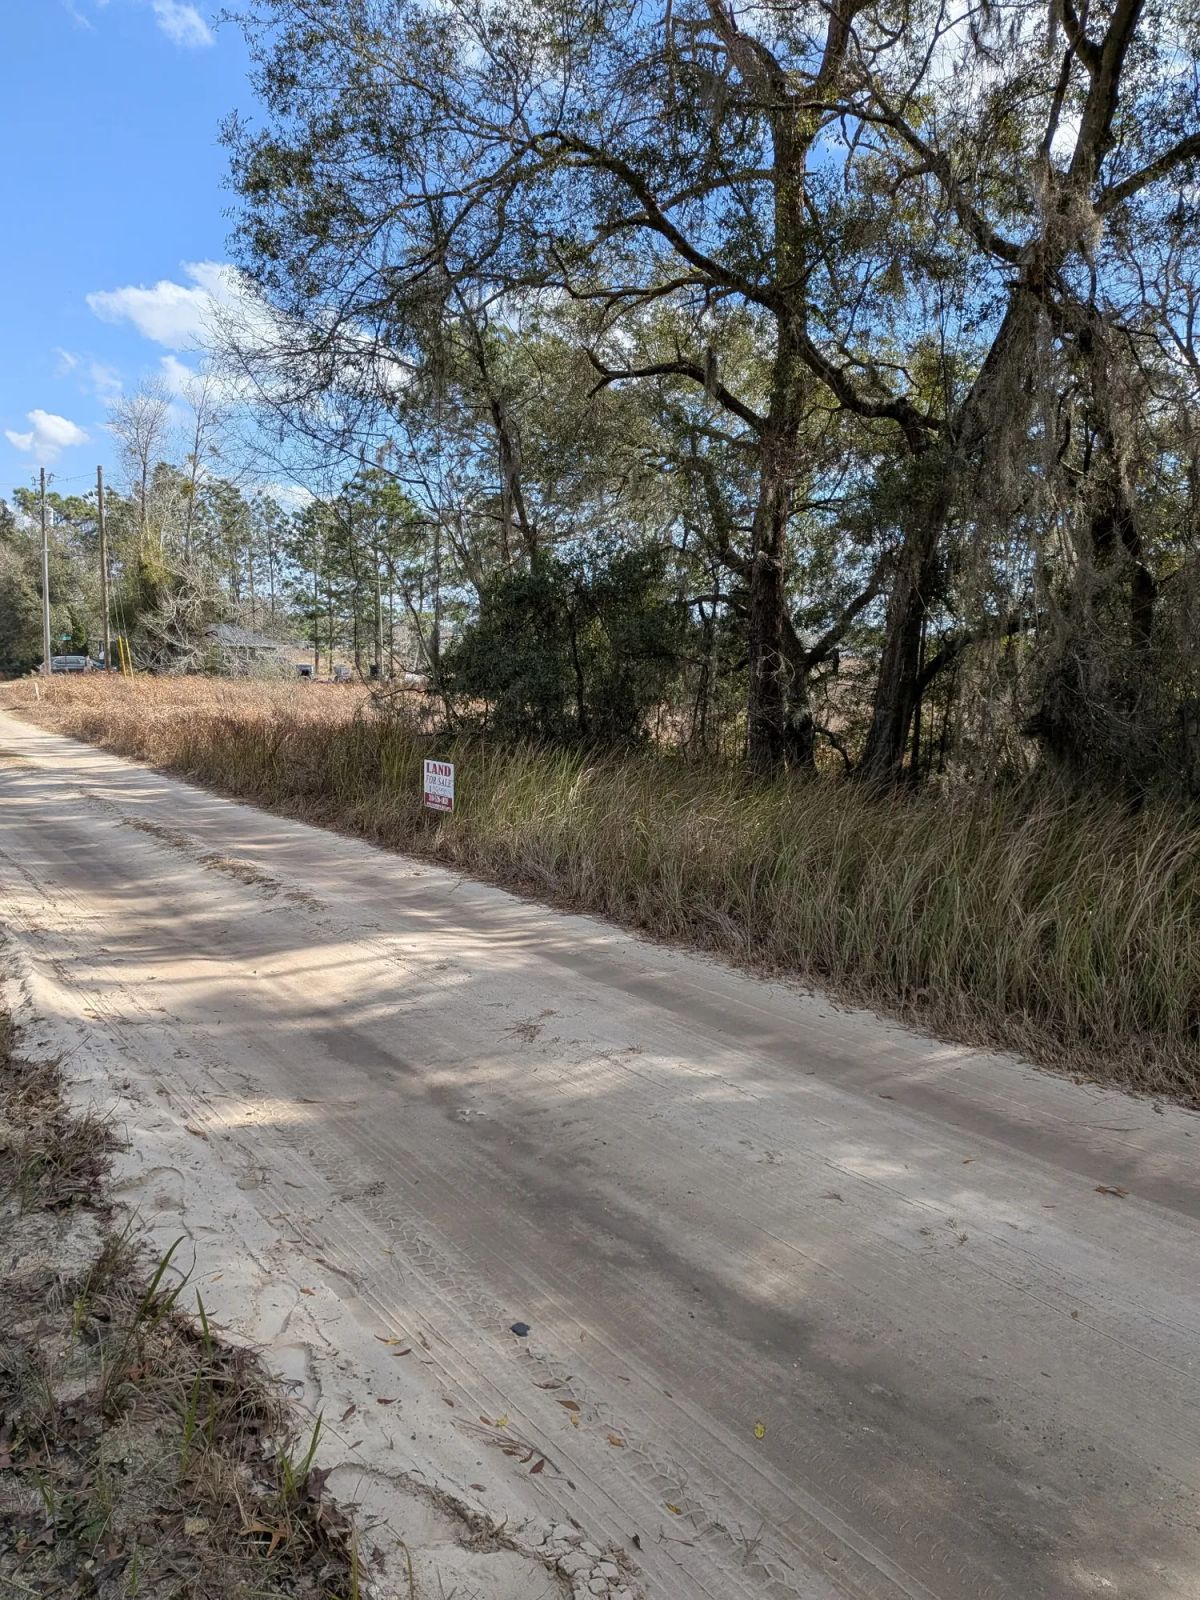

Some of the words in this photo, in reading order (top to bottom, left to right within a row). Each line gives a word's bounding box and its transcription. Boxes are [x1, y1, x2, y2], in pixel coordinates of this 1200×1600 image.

[426, 762, 451, 777] LAND
[426, 775, 437, 784] FOR
[438, 777, 451, 787] SALE
